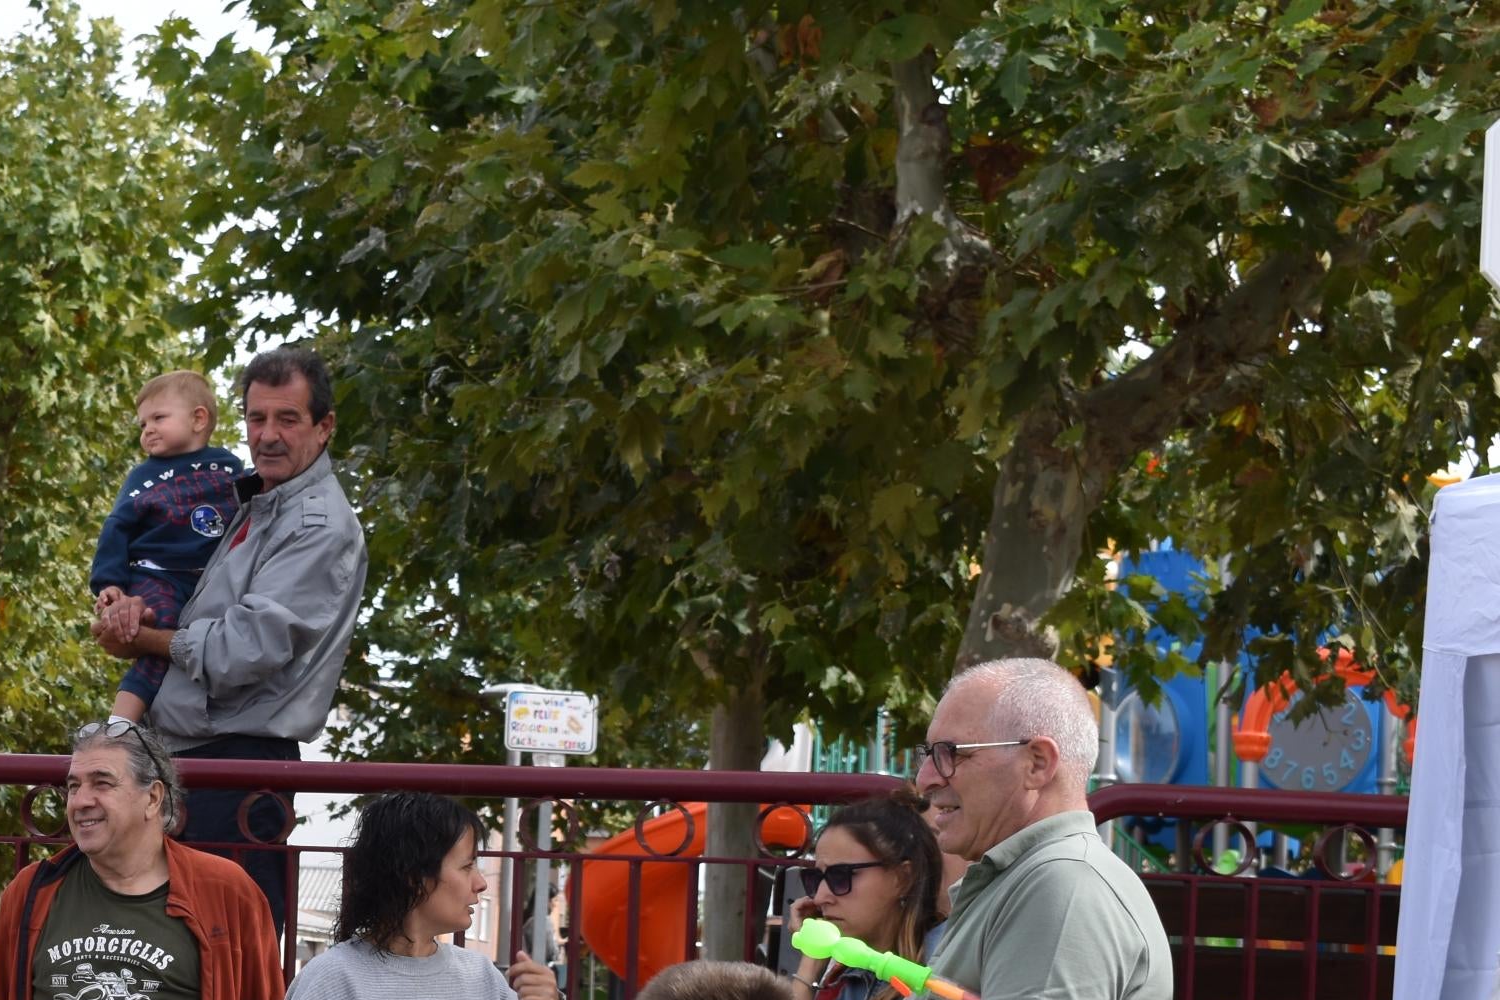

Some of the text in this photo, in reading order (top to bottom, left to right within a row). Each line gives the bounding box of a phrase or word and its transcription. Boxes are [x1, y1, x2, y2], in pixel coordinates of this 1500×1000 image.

[1341, 703, 1356, 725] 2
[1351, 728, 1365, 751] 3
[1264, 747, 1283, 769] 8
[1339, 748, 1355, 770] 4
[1281, 760, 1298, 782] 7
[1301, 766, 1316, 789] 6
[1322, 762, 1338, 785] 5
[92, 924, 136, 935] American
[47, 936, 175, 970] MOTORCYCLES
[102, 954, 141, 966] ACCESSORIES
